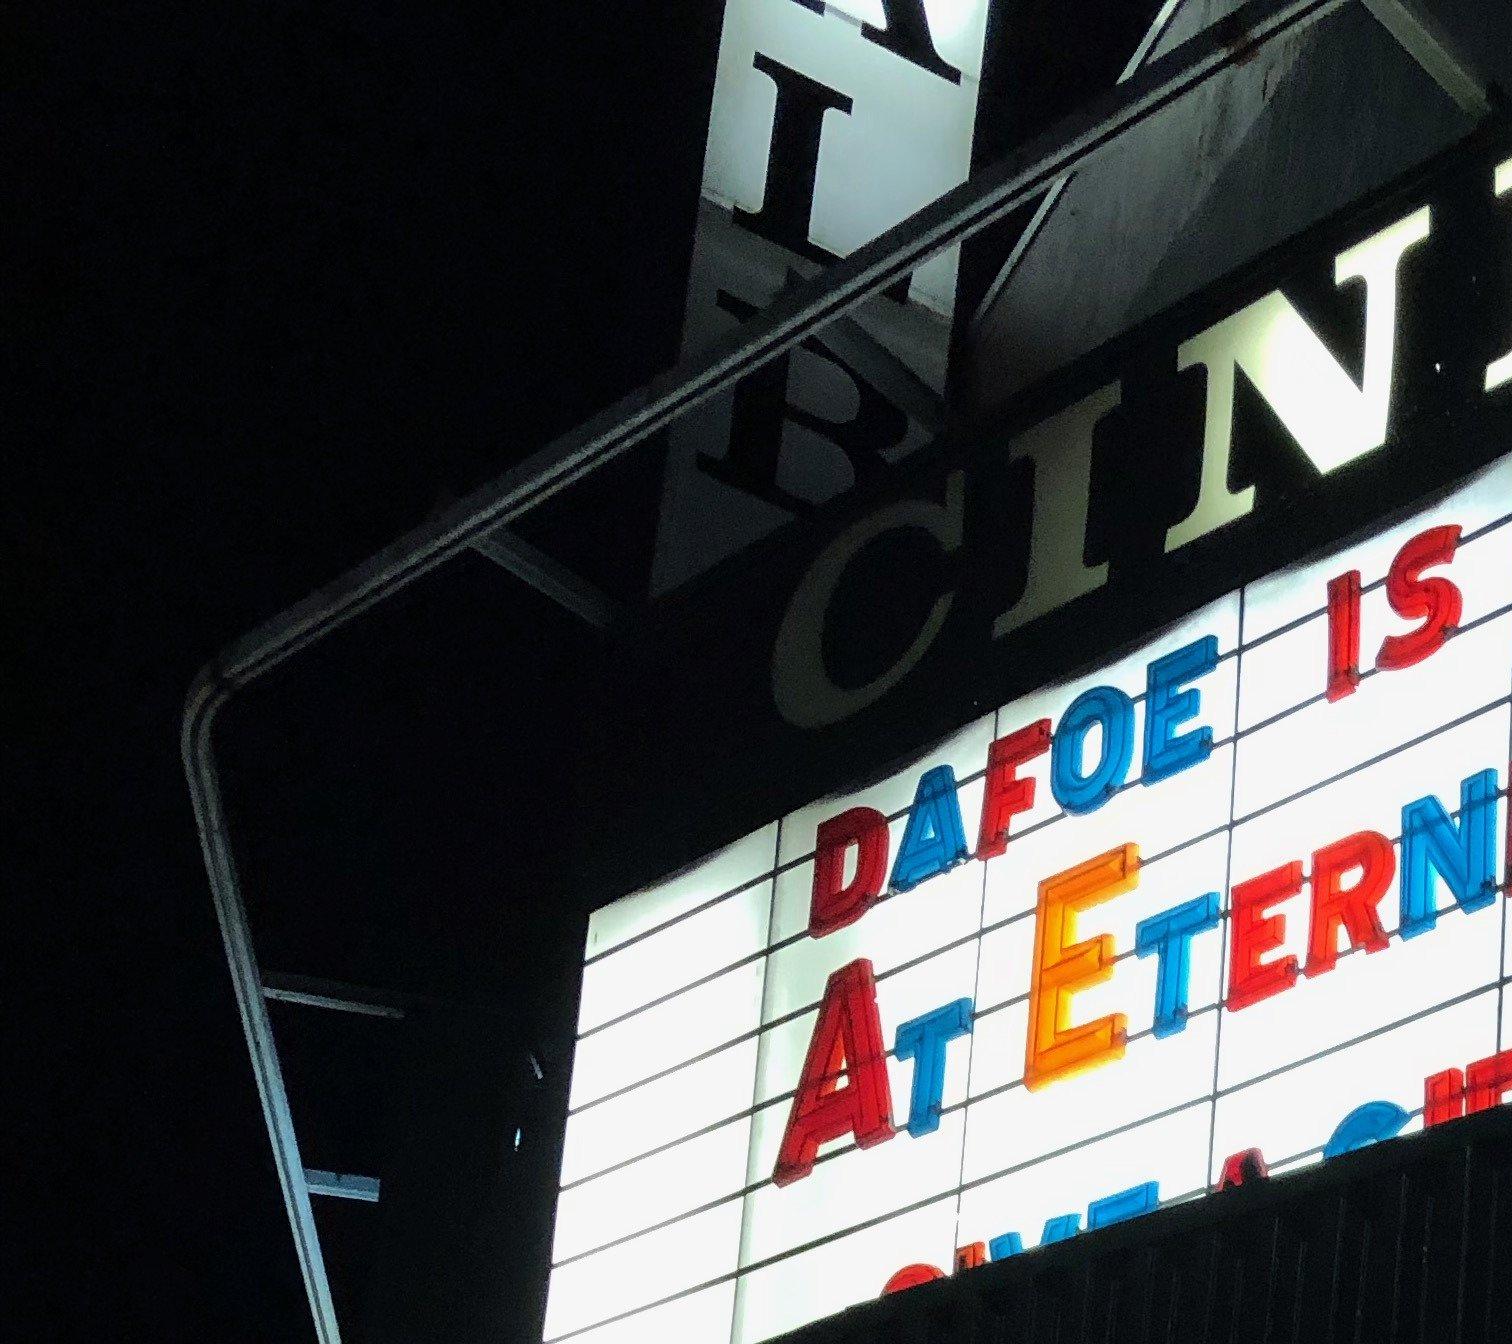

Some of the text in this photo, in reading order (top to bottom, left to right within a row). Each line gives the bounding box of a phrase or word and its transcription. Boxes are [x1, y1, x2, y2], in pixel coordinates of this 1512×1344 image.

[808, 634, 1220, 938] DAFOE
[1326, 523, 1463, 702] IS
[772, 958, 972, 1187] AT
